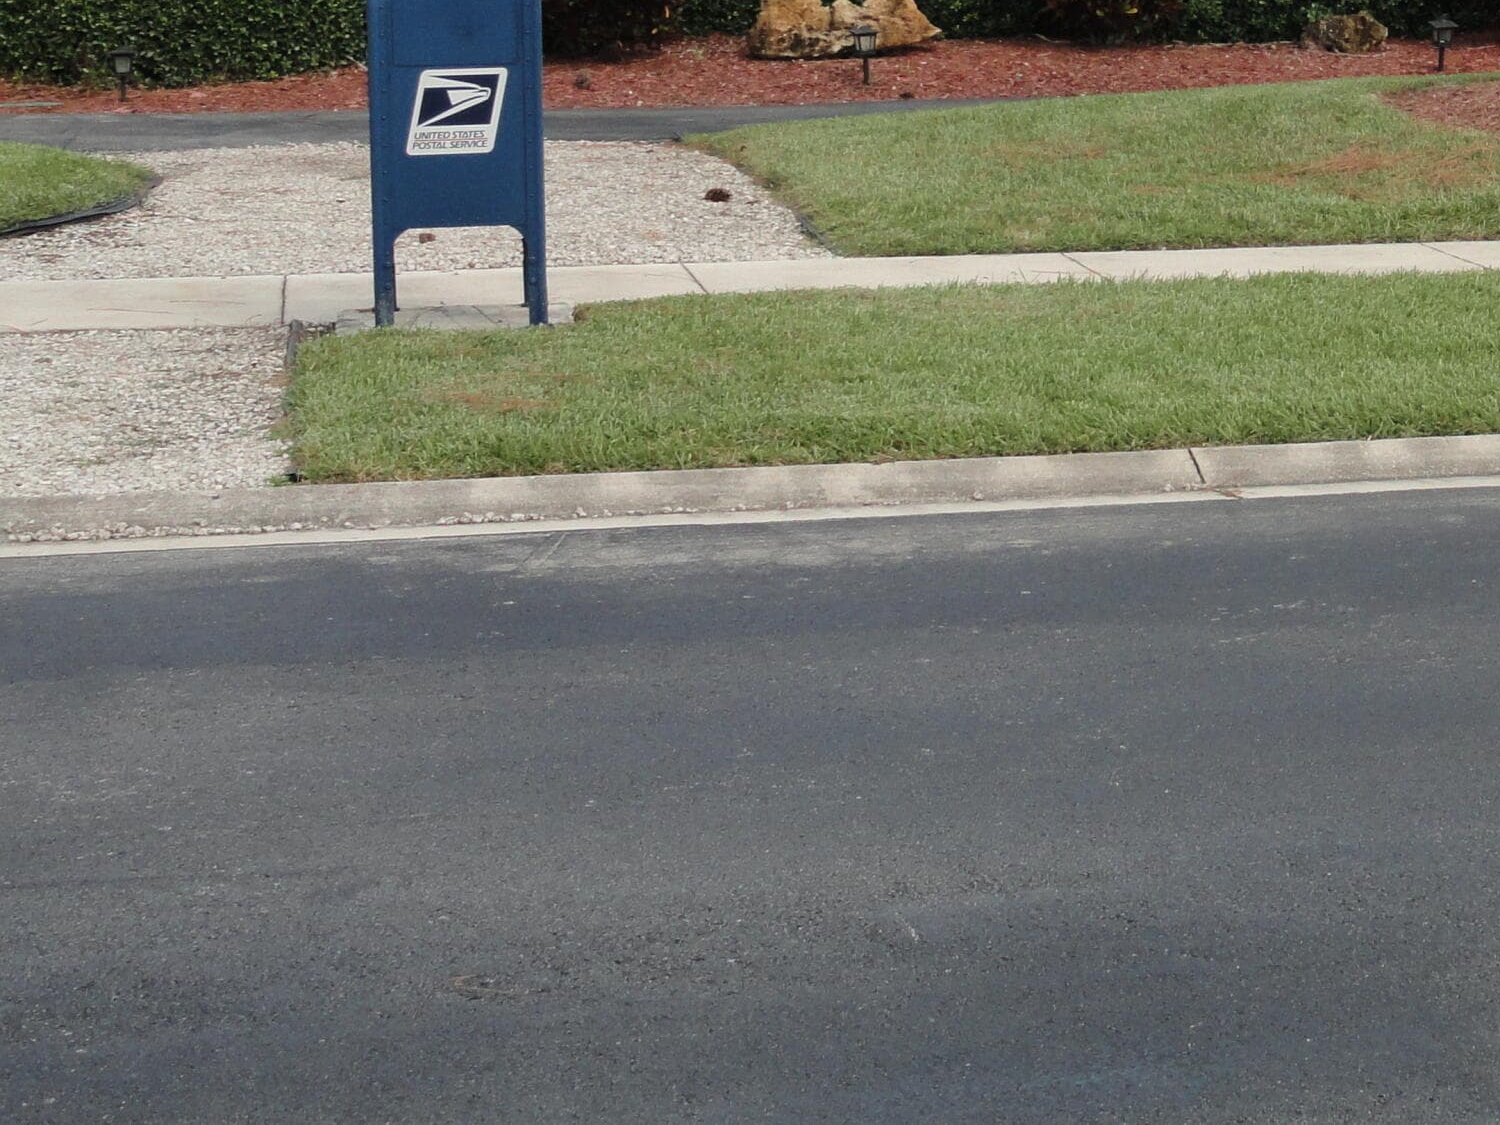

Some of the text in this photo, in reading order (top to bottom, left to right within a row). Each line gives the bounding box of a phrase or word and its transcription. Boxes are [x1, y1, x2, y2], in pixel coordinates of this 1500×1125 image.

[414, 130, 486, 139] UNITED STATES
[412, 140, 488, 149] POSTAL SERVICE
